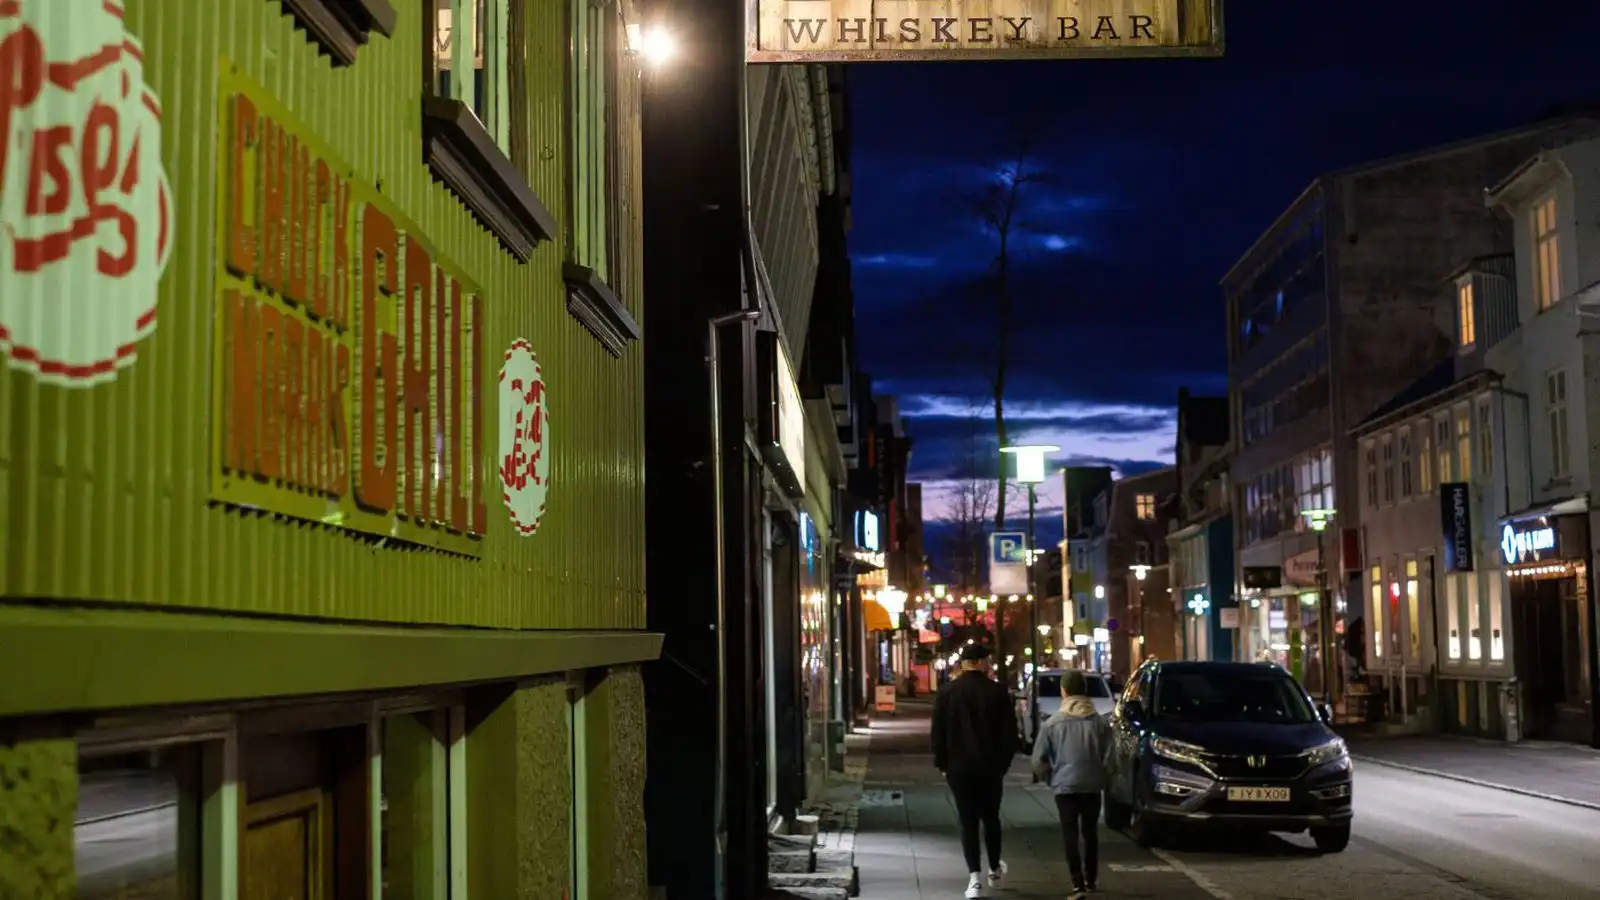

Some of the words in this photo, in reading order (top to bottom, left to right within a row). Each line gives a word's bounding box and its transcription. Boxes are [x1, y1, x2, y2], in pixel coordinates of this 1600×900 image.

[783, 17, 1032, 43] WHISKEY
[1057, 15, 1154, 41] BAR
[230, 92, 349, 331] CHUCK
[224, 288, 349, 496] NORRIS
[1000, 539, 1016, 559] P
